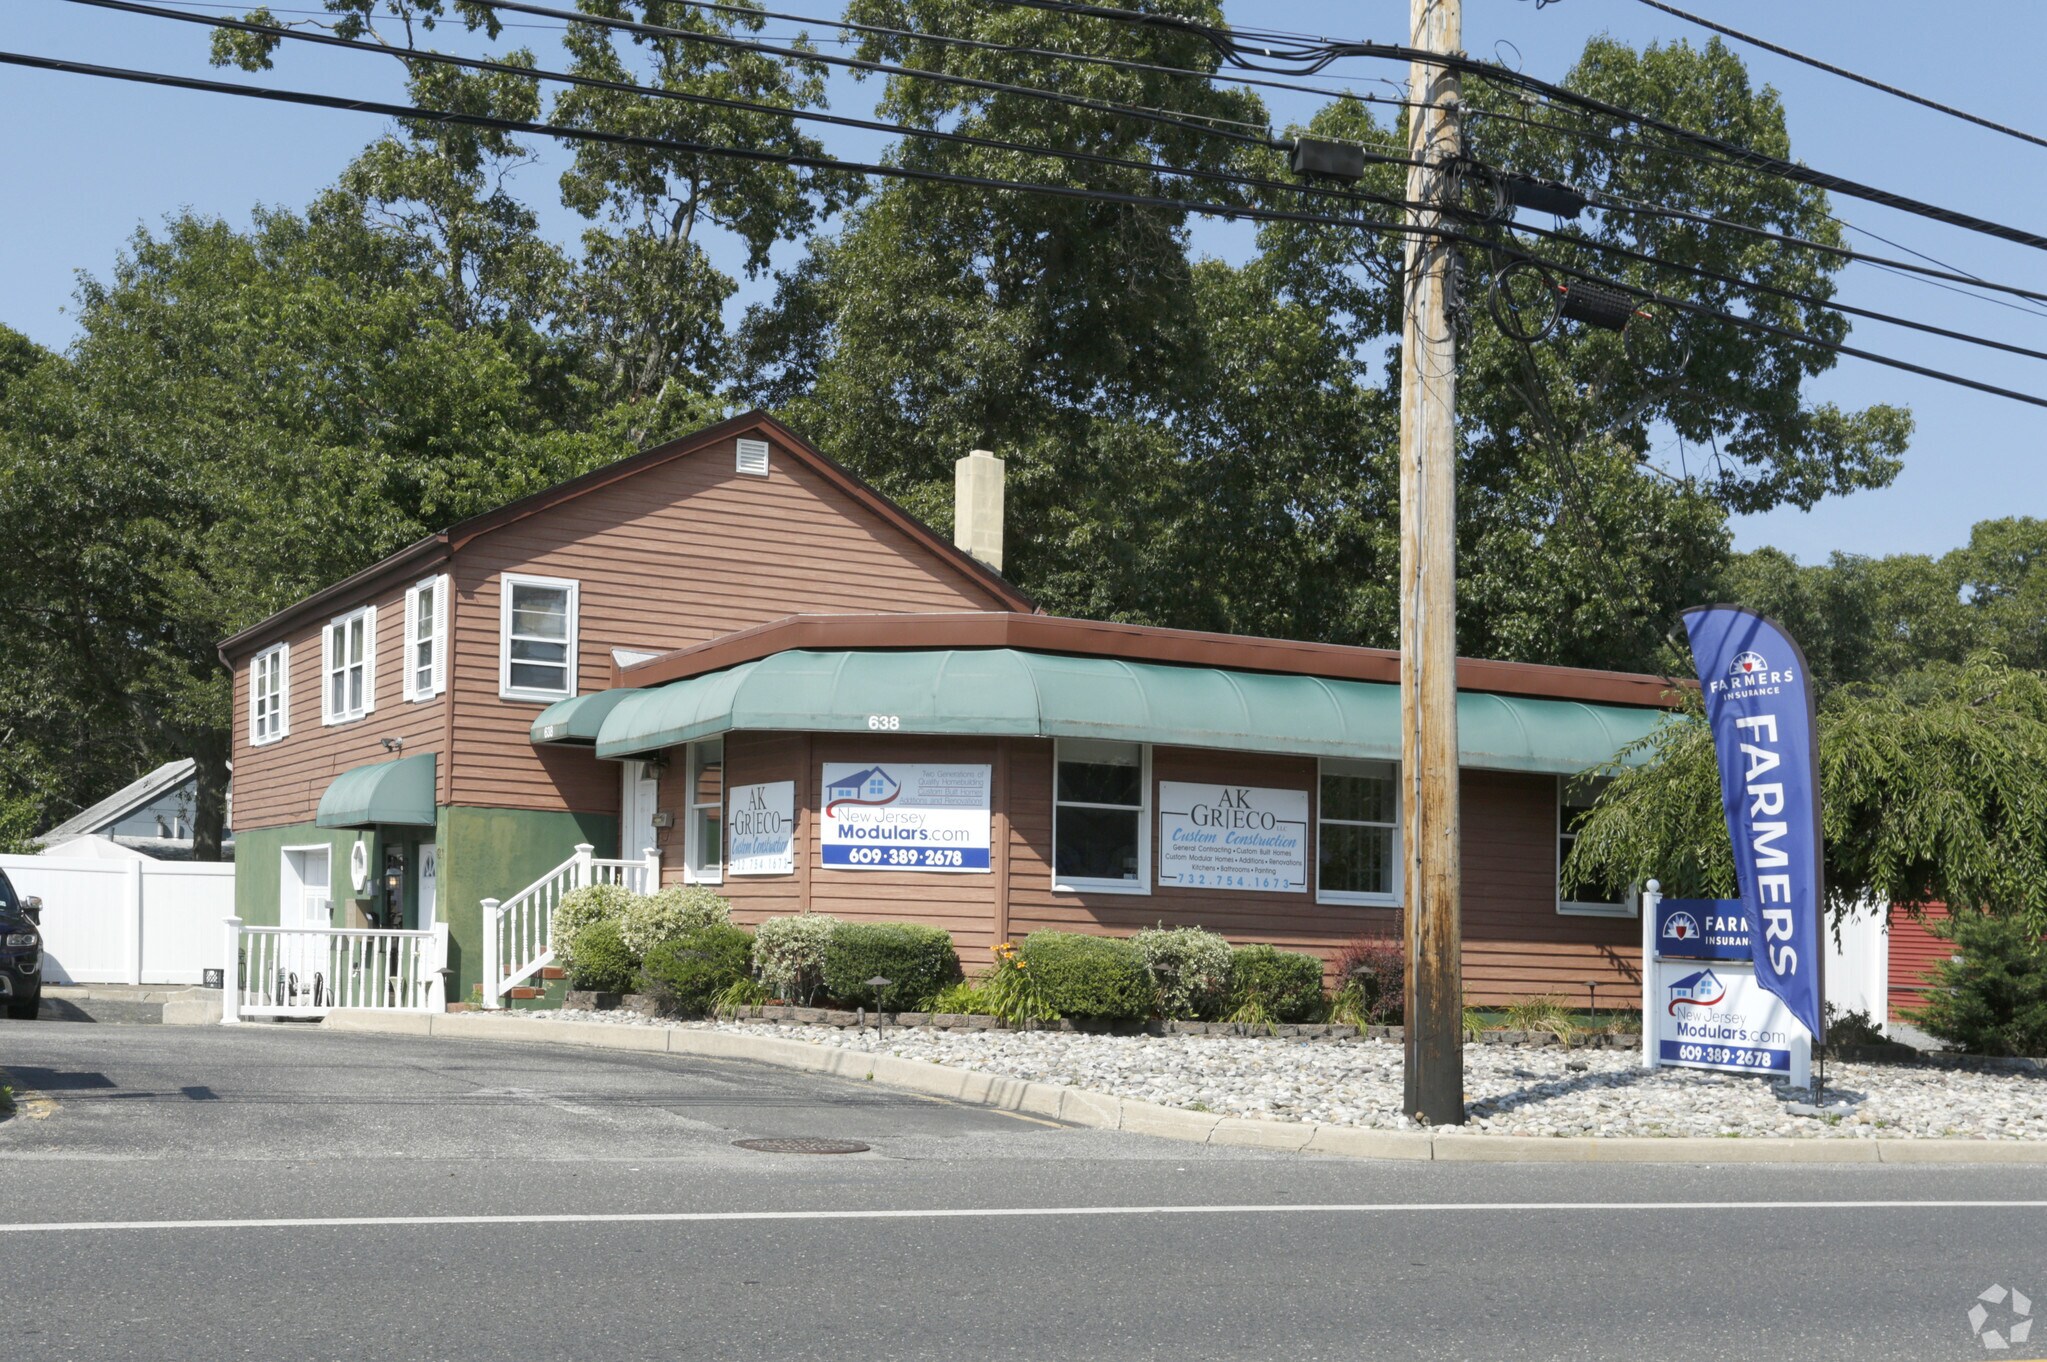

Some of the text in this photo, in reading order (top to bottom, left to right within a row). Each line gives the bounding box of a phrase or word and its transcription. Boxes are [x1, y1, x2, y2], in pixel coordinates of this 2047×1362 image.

[1709, 670, 1794, 693] FARMERS
[1723, 687, 1780, 701] INSURANCE
[868, 715, 900, 730] 638
[748, 786, 767, 811] AK
[1218, 788, 1252, 809] AK
[735, 809, 781, 837] GRIECO
[837, 807, 926, 829] New Jersey
[1191, 803, 1276, 830] GRIECO
[838, 824, 970, 841] Modulars.com
[1172, 827, 1297, 848] Custom Construction
[1172, 844, 1291, 857] General Contracting Custom Built Homes
[1735, 714, 1798, 976] FARMERS
[1165, 853, 1302, 867] Custom Modular Homes Additions Renovations
[1191, 864, 1277, 875] Kitchens Bathrooms Painting
[1705, 916, 1749, 932] FARM
[1705, 936, 1751, 946] INSURAN
[1677, 1006, 1747, 1029] New Jersey
[1677, 1022, 1786, 1044] Modulars.com
